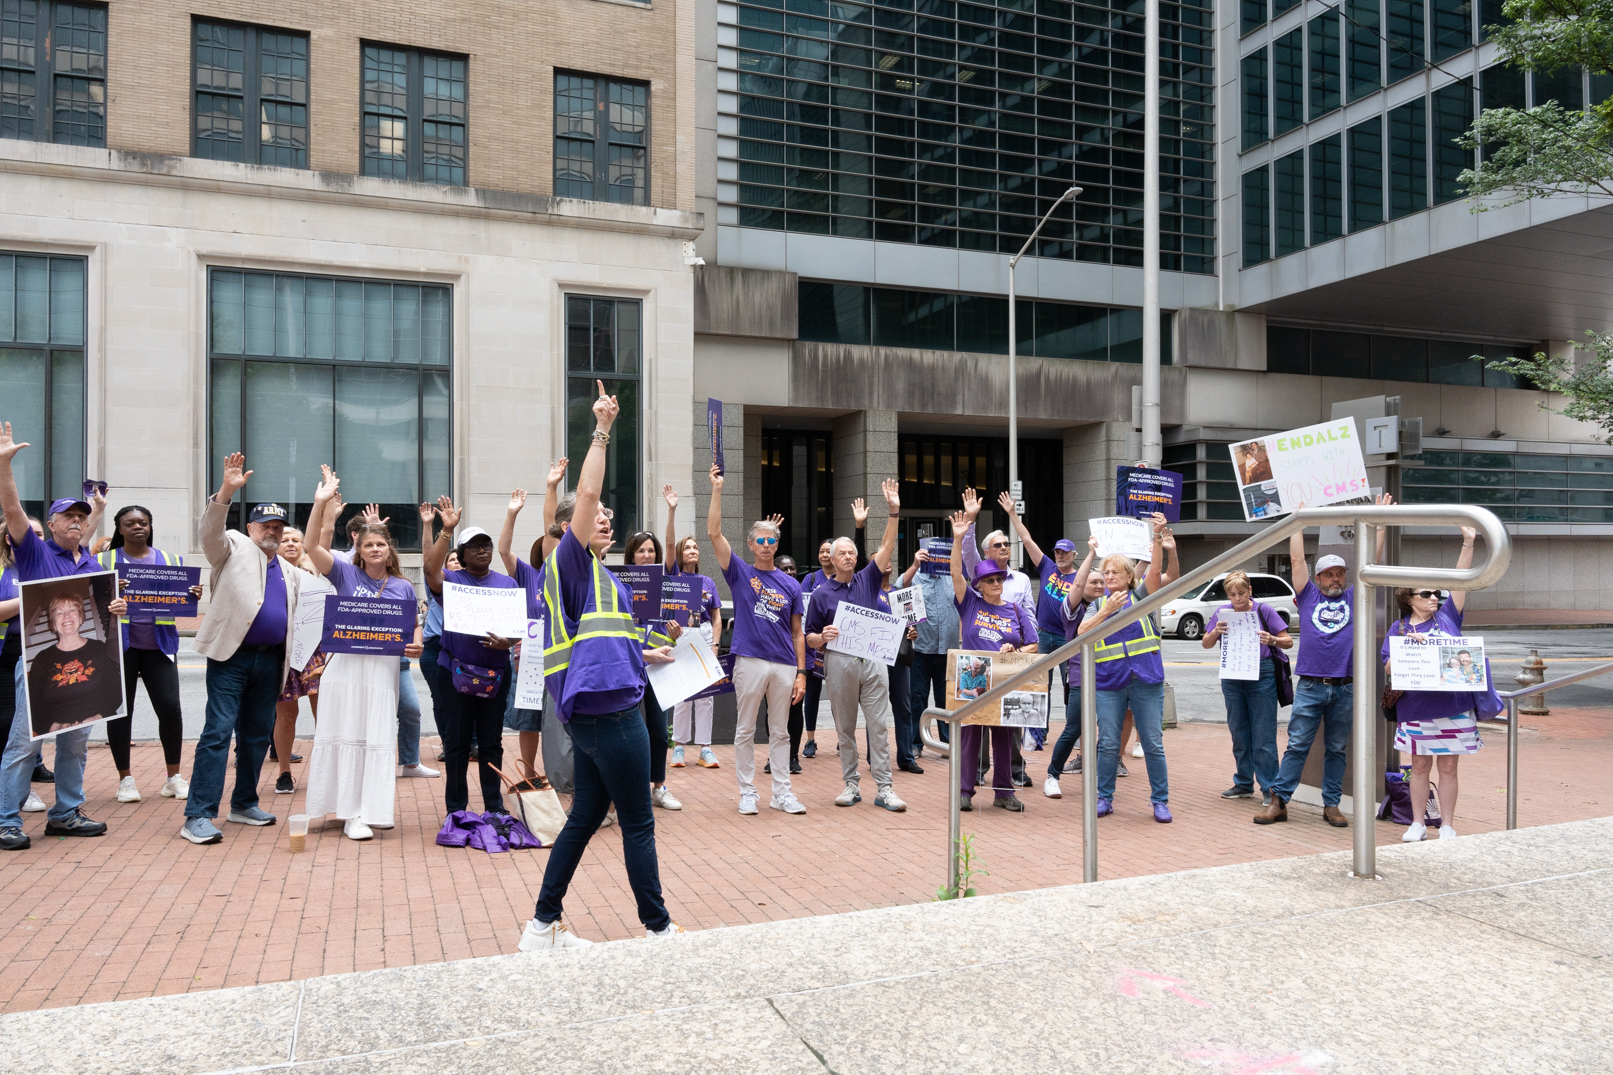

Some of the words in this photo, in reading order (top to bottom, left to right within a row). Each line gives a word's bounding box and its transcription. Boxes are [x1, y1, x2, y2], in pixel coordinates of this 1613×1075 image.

[1267, 426, 1351, 453] #ENDALZ
[1374, 424, 1388, 448] T
[1278, 455, 1314, 473] STARTS
[1321, 448, 1345, 461] WITH
[1281, 482, 1313, 506] YOU
[1323, 478, 1366, 498] CMS!
[1129, 494, 1173, 505] ALZHEIMER'S.
[263, 506, 284, 516] ARMY
[1097, 519, 1144, 528] #ACCESSNOW
[1103, 544, 1126, 554] MORE
[451, 585, 517, 597] #ACCESSNOW
[897, 590, 912, 603] MORE
[122, 595, 188, 604] ALZHEIMER'S.
[844, 605, 900, 624] #ACCESSNOW
[332, 631, 403, 642] ALZHEIMER'S.
[870, 627, 897, 643] FIX
[835, 634, 864, 652] THIS
[867, 642, 897, 658] MESS!
